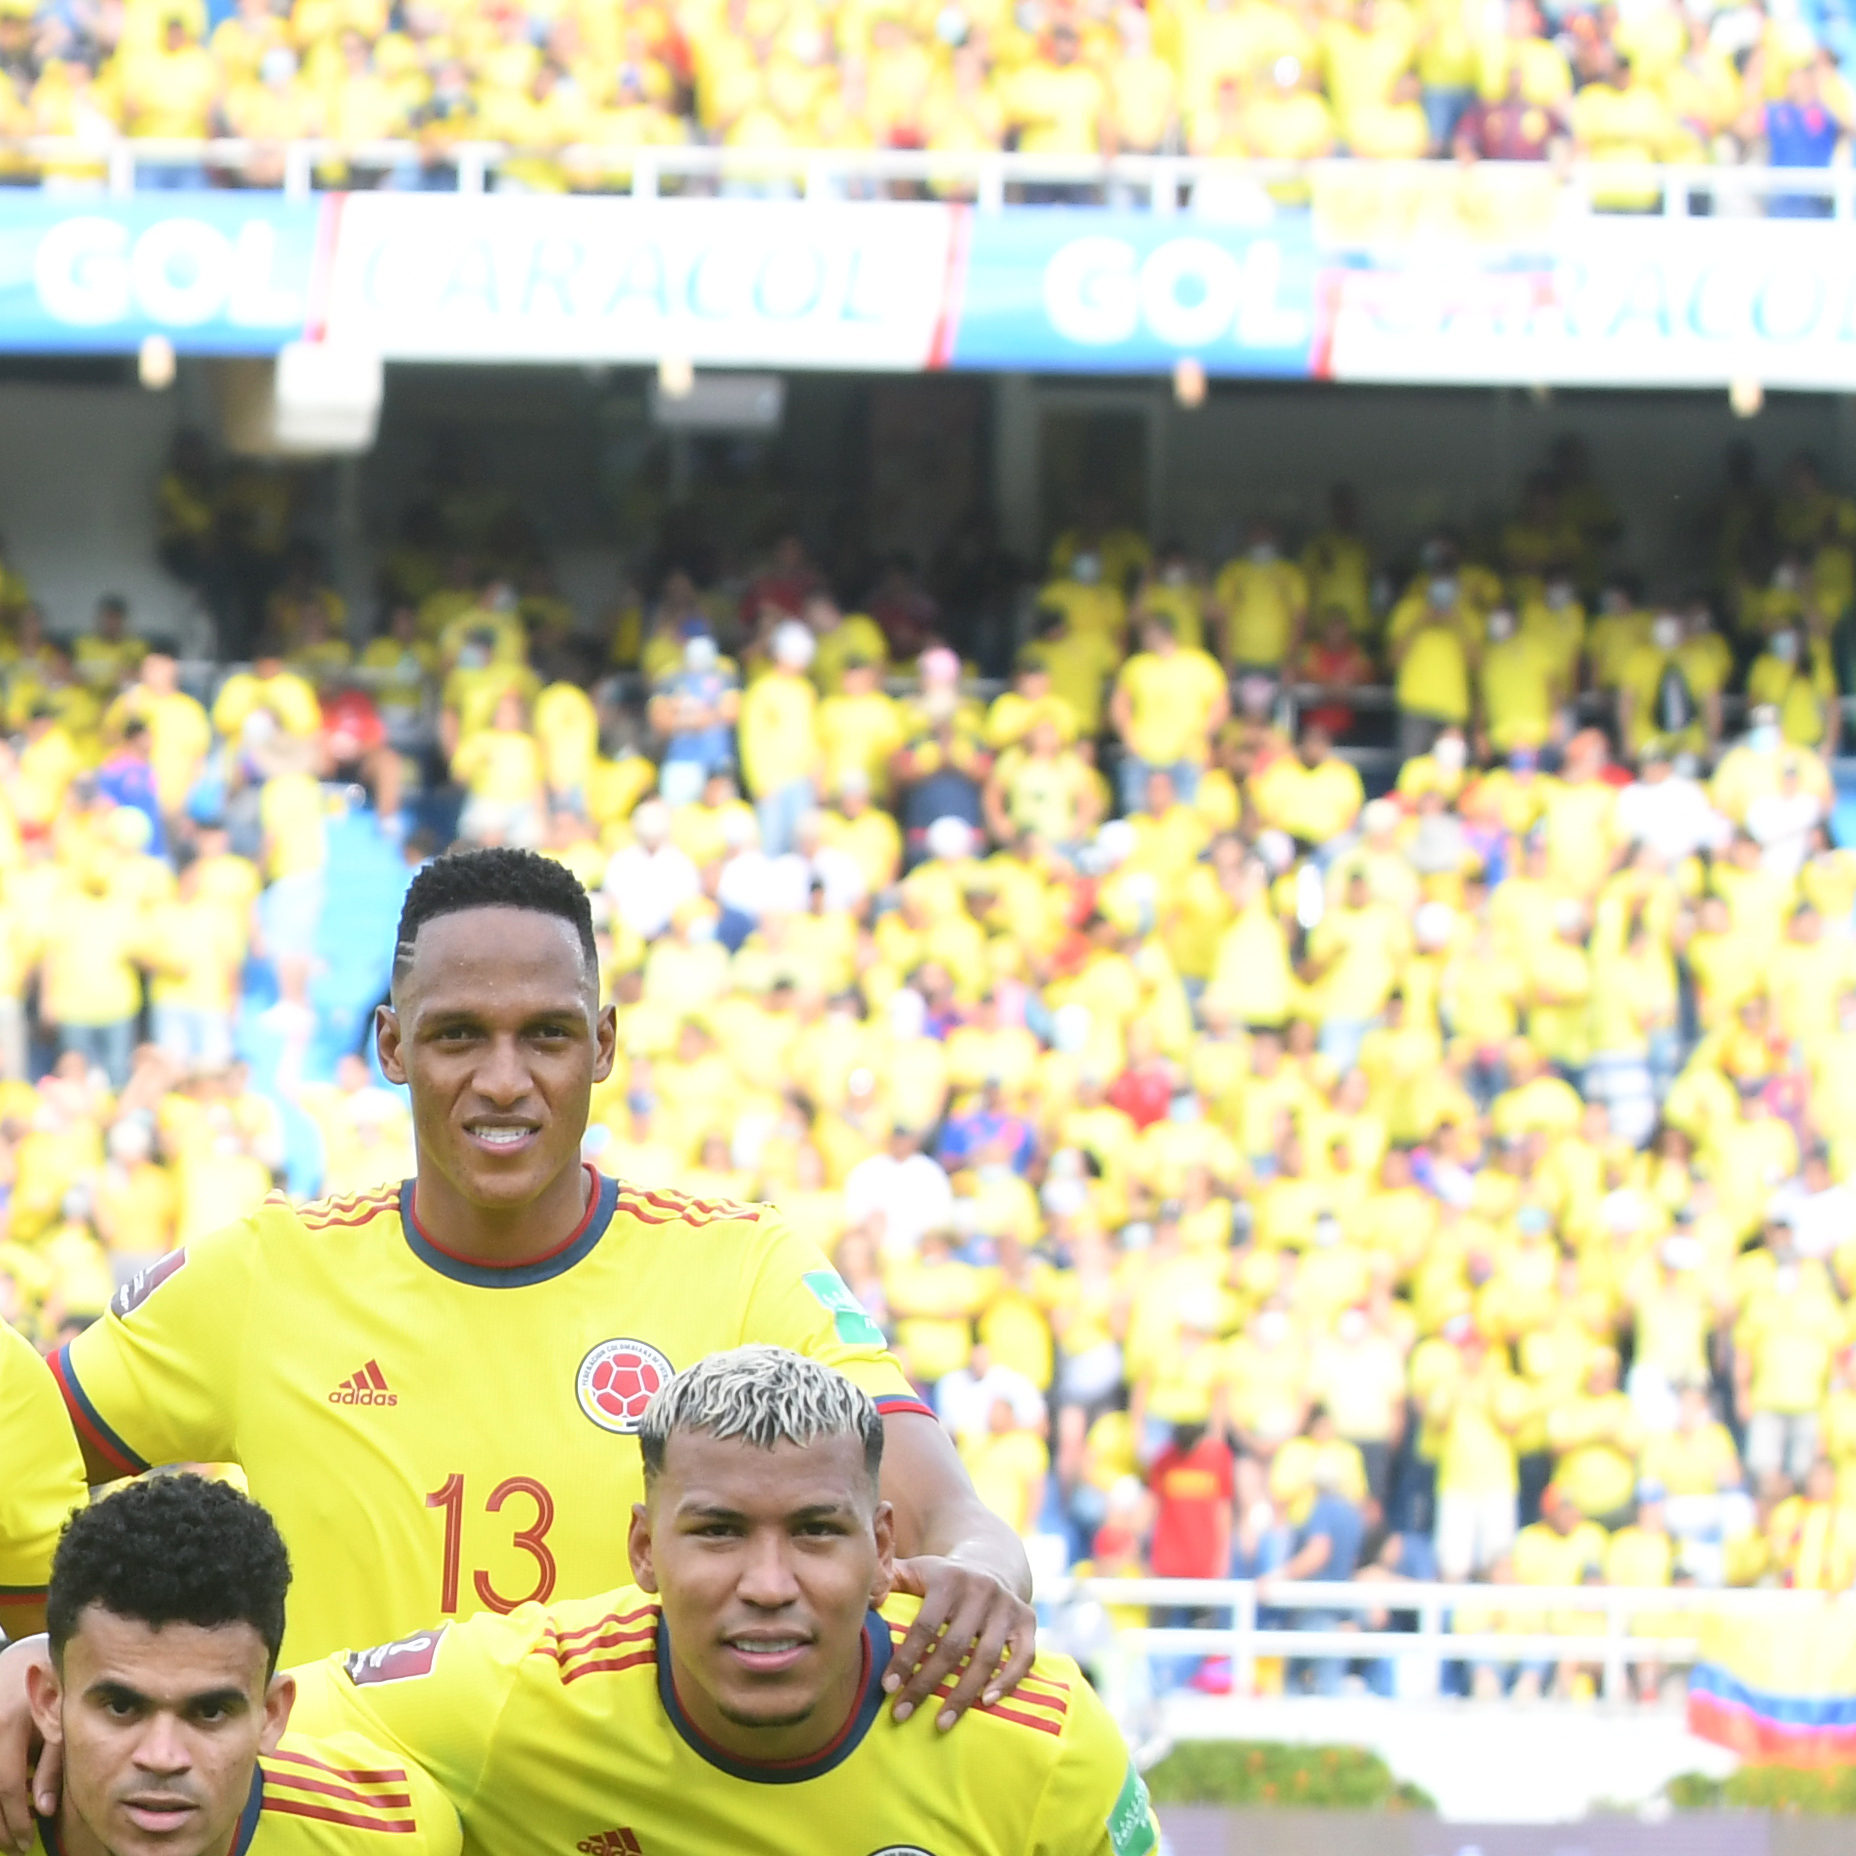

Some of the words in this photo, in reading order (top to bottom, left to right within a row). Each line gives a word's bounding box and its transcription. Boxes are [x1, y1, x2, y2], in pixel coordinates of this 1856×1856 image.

[34, 215, 307, 327] GOL
[361, 235, 886, 323] CARACOL
[1042, 237, 1309, 345] GOL
[328, 1384, 398, 1407] adidas
[426, 1473, 558, 1616] 13
